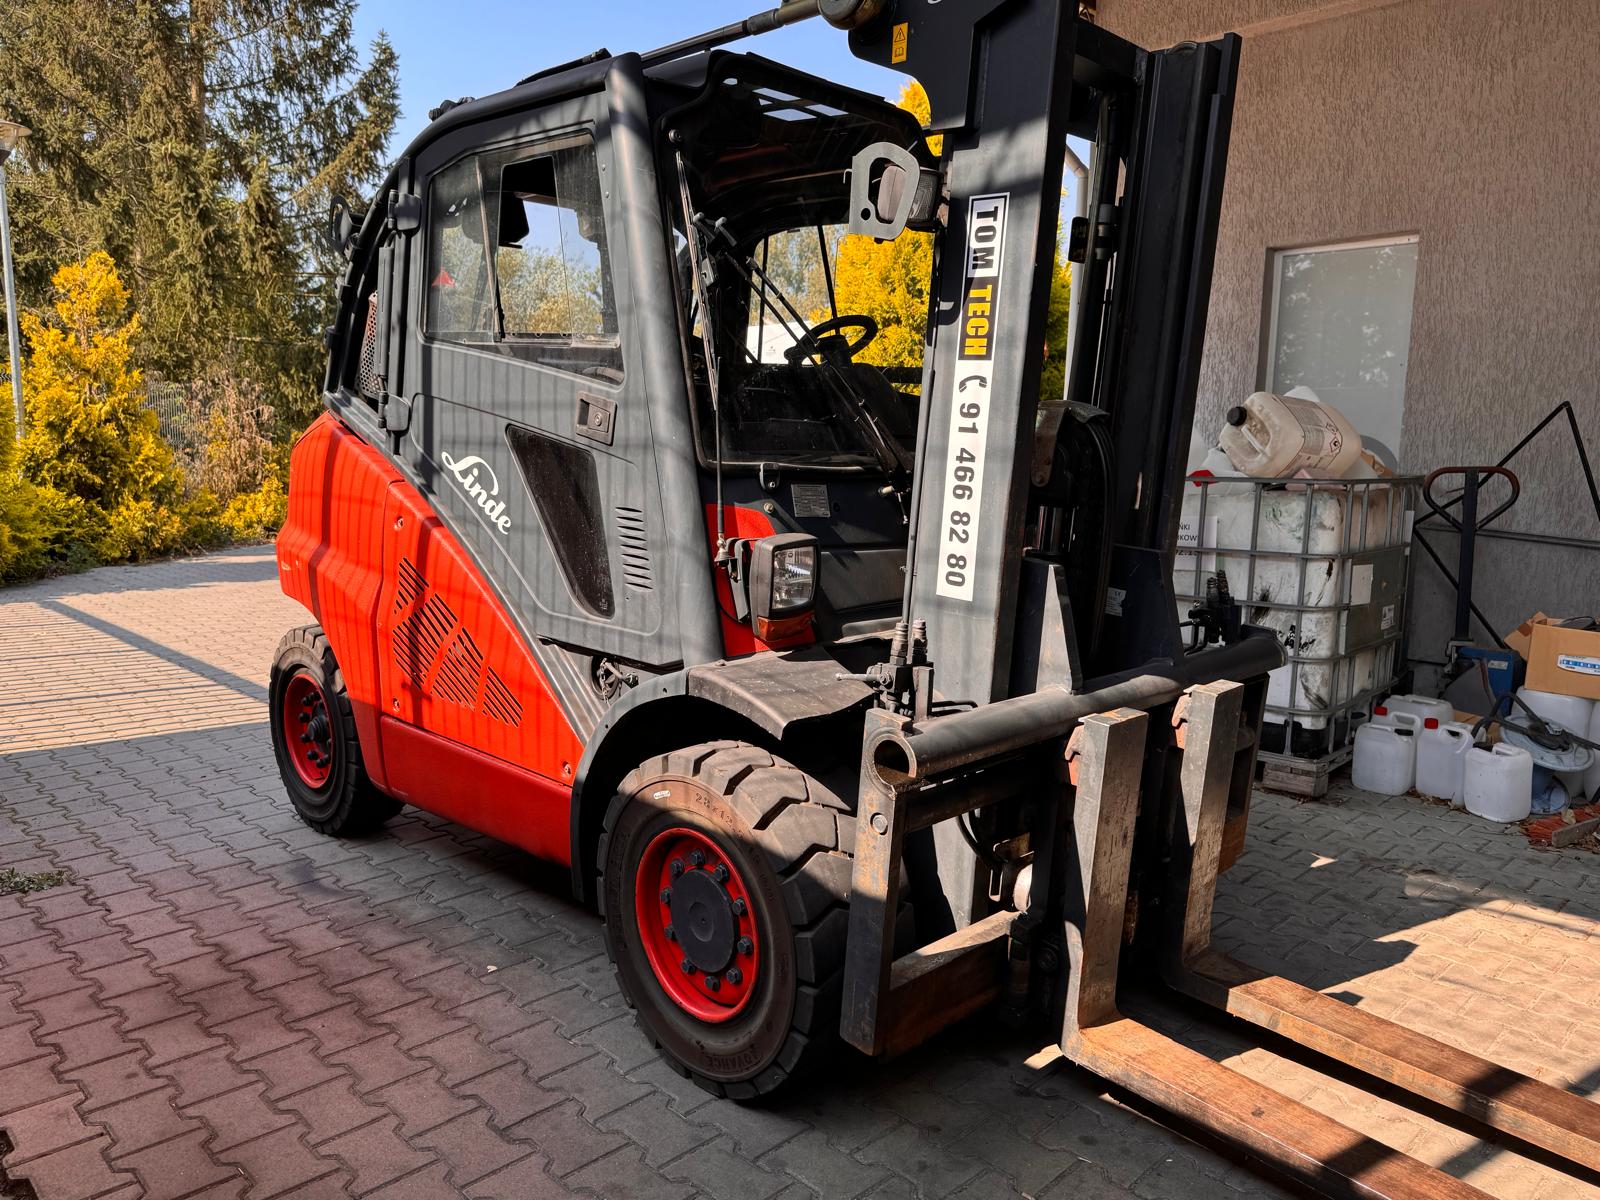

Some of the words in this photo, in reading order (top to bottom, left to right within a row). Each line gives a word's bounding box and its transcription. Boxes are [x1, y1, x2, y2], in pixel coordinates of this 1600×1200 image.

[972, 206, 998, 270] TOM
[964, 284, 992, 356] TECH
[958, 402, 981, 434] 91
[441, 451, 512, 535] Linde
[952, 447, 976, 500] 466
[949, 510, 971, 544] 82
[945, 553, 967, 587] 80
